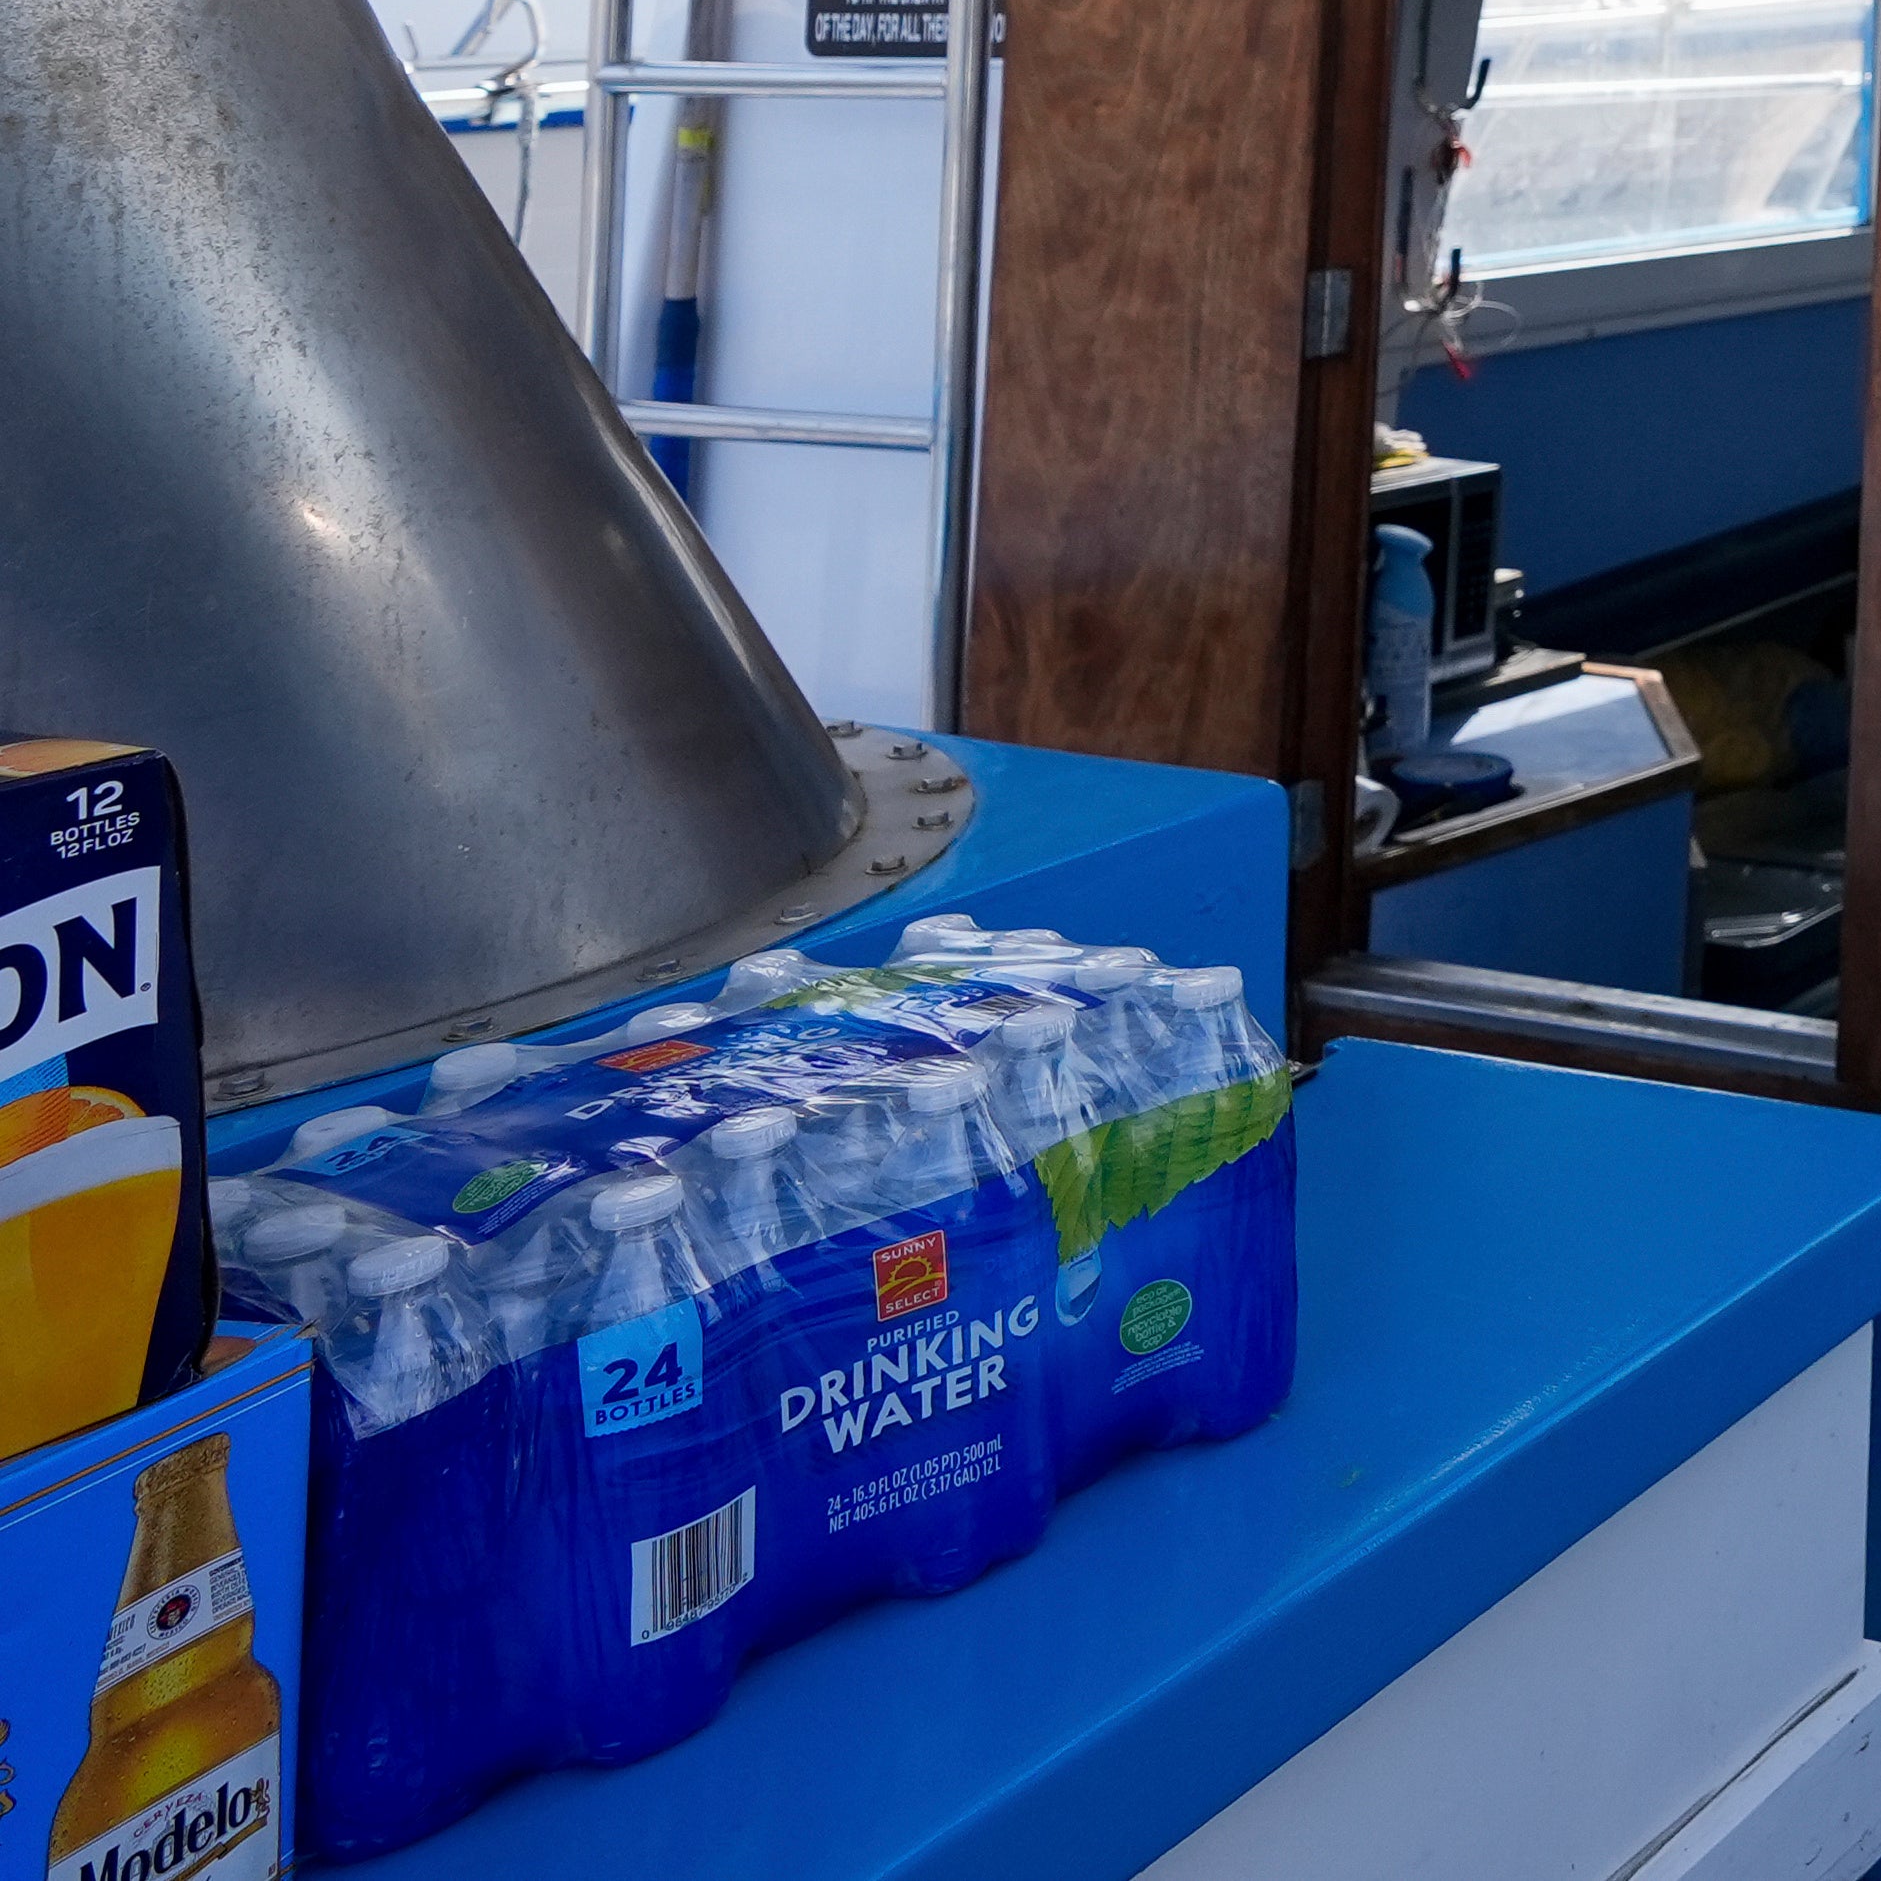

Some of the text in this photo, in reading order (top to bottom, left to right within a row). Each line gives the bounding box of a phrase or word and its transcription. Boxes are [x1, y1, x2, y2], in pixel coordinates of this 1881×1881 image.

[814, 13, 830, 42] OF
[831, 13, 852, 42] THE
[877, 13, 899, 42] FOR
[900, 13, 921, 42] ALL
[66, 780, 124, 820] 12
[50, 812, 140, 846] BOTTLES
[56, 829, 134, 859] 12 FL OZ
[880, 1236, 937, 1263] SUNNY
[885, 1286, 940, 1314] SELECT
[867, 1310, 960, 1353] PURIFIED
[602, 1342, 683, 1405] 24
[780, 1294, 1039, 1433] DRINKING
[595, 1383, 695, 1425] BOTTLES
[822, 1354, 1007, 1454] WATER
[827, 1494, 841, 1516] 24
[852, 1481, 876, 1504] 16.9
[878, 1475, 890, 1495] FL
[892, 1467, 907, 1489] OZ
[910, 1456, 939, 1484] (1.05
[941, 1451, 961, 1472] PT)
[963, 1440, 985, 1464] 500
[987, 1433, 1003, 1455] mL
[829, 1509, 851, 1534] NET
[853, 1496, 887, 1522] 405.6
[889, 1491, 901, 1511] FL
[903, 1483, 919, 1504] OZ
[953, 1464, 981, 1488] GAL)
[983, 1457, 993, 1477] 12
[995, 1453, 1001, 1472] L
[642, 1629, 650, 1640] 0
[133, 1791, 204, 1838] CERVEZA
